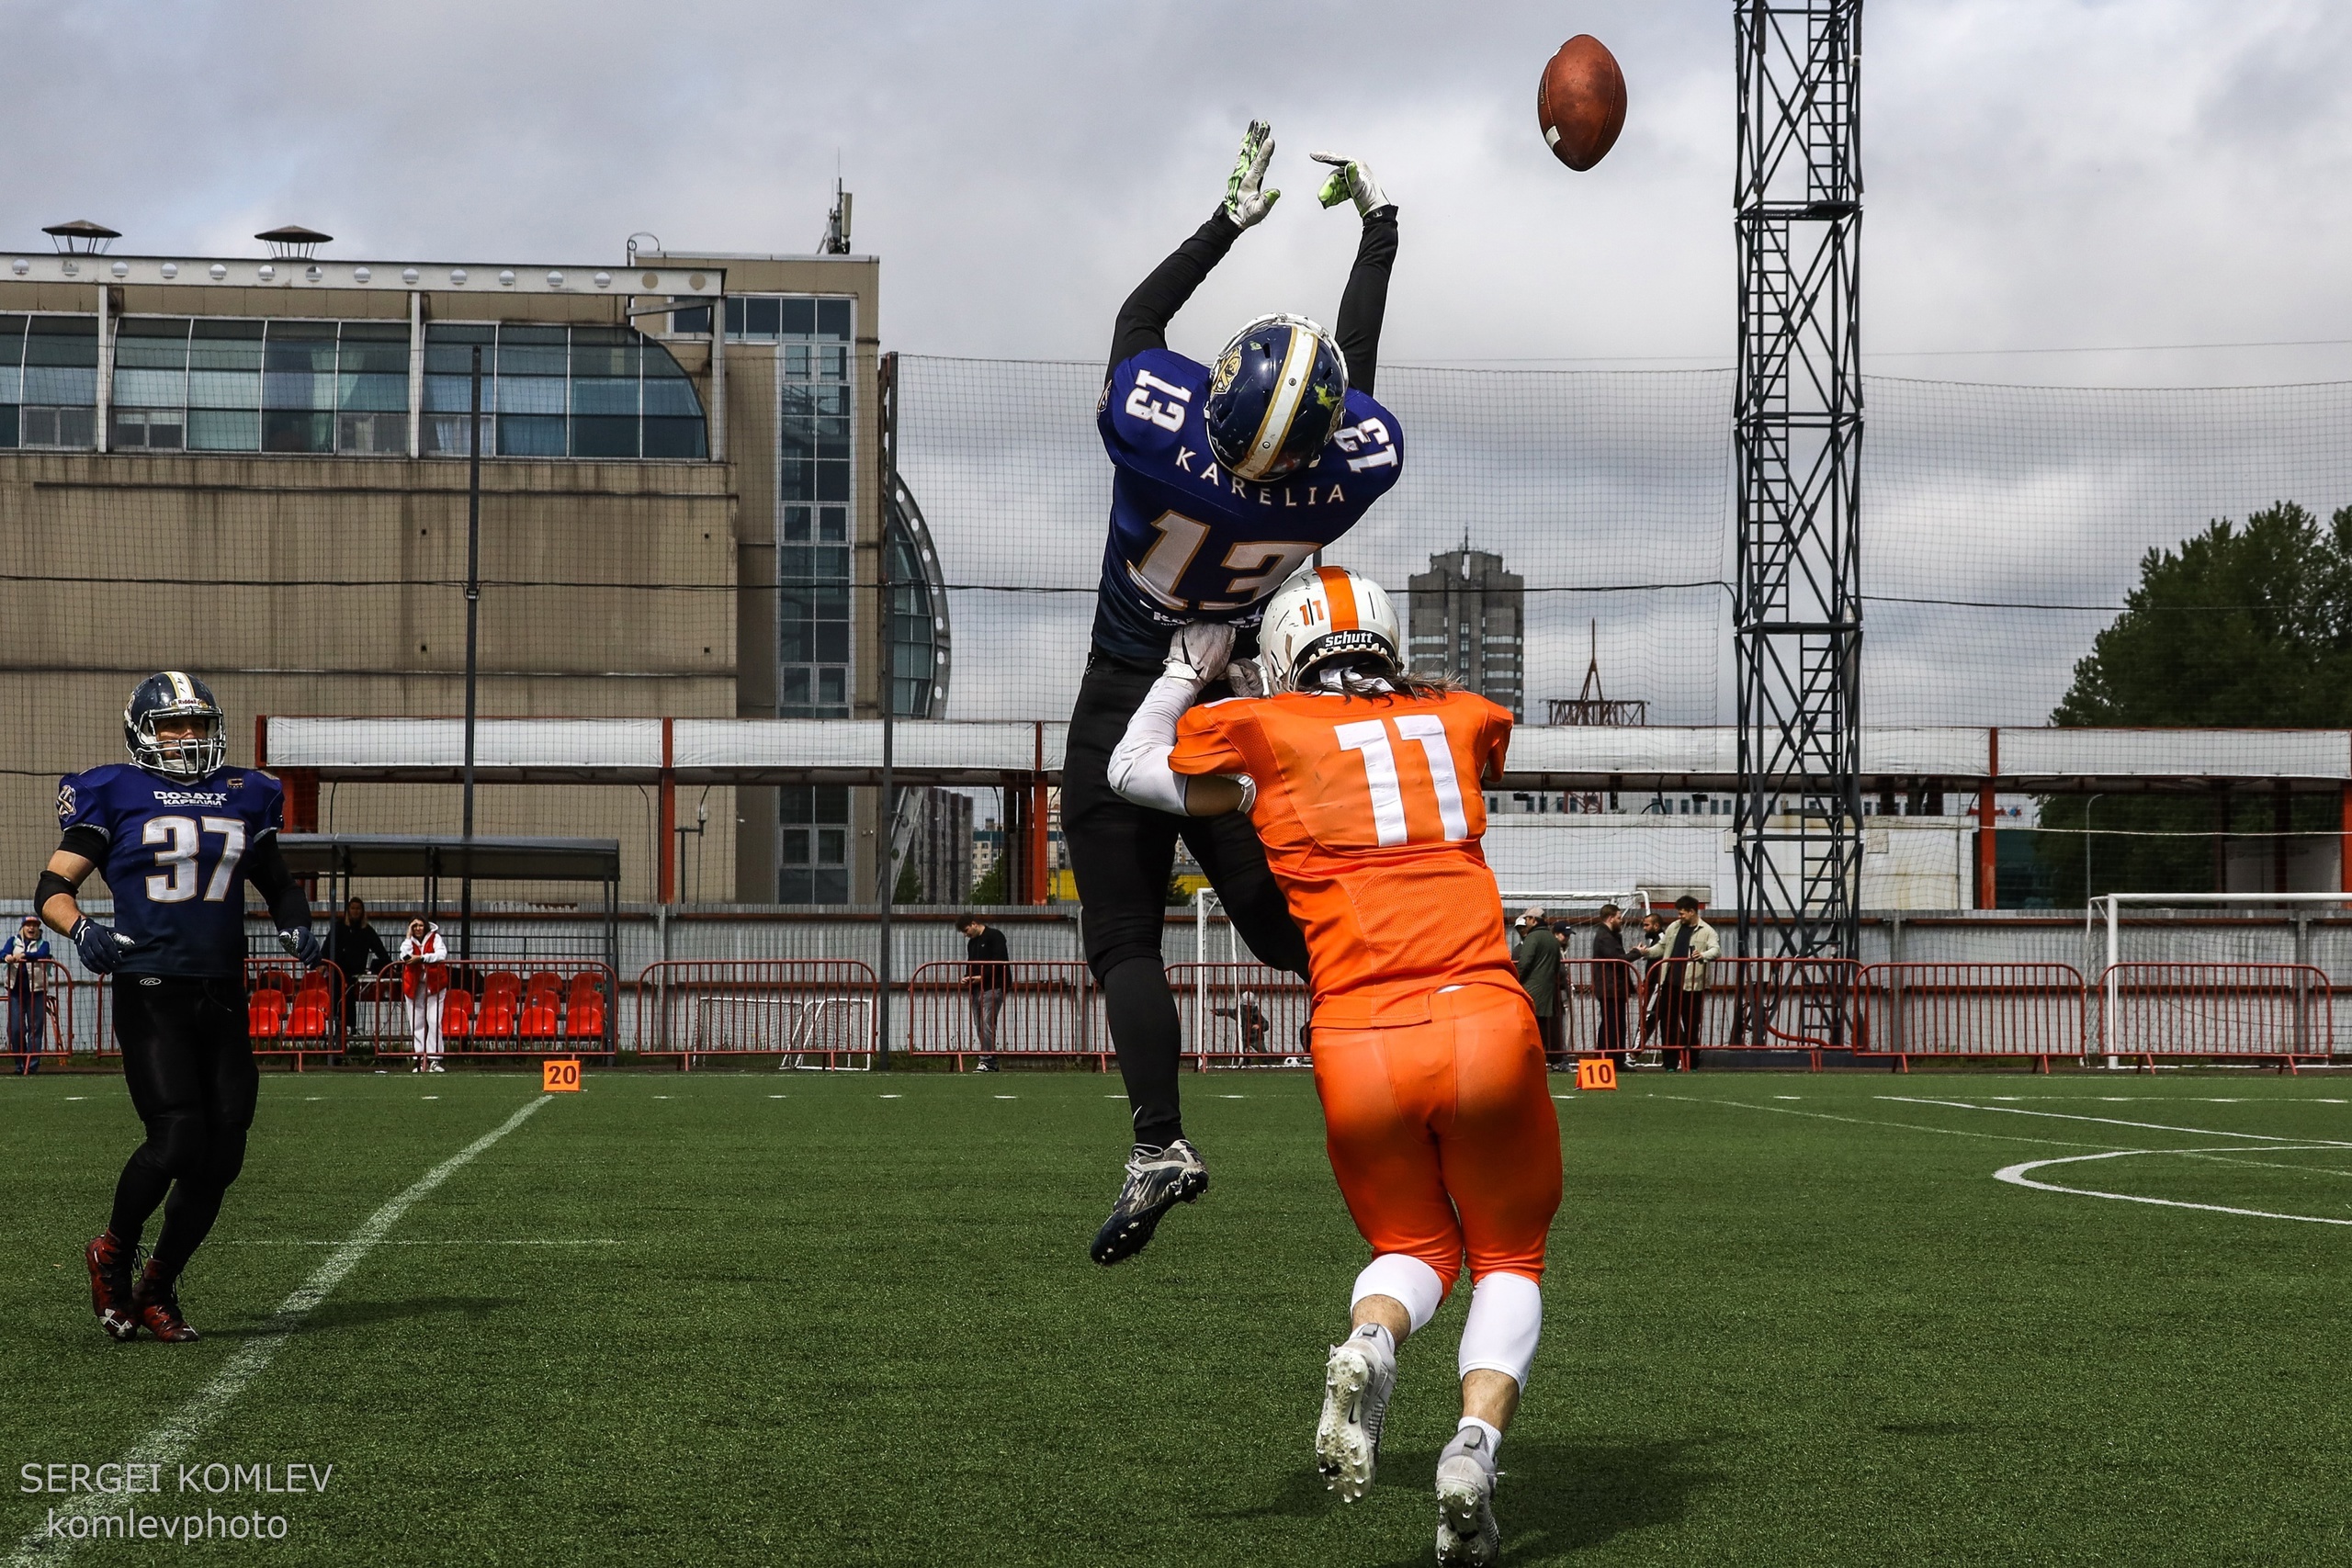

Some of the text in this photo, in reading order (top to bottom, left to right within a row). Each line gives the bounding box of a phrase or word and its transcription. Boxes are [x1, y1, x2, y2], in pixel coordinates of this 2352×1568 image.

[1125, 369, 1193, 433] 13
[1334, 417, 1398, 473] 13
[1175, 446, 1345, 506] KARELIA
[1299, 600, 1324, 626] 11
[1333, 715, 1468, 848] 11
[142, 815, 246, 903] 37
[548, 1066, 577, 1085] 20
[1586, 1064, 1612, 1085] 10
